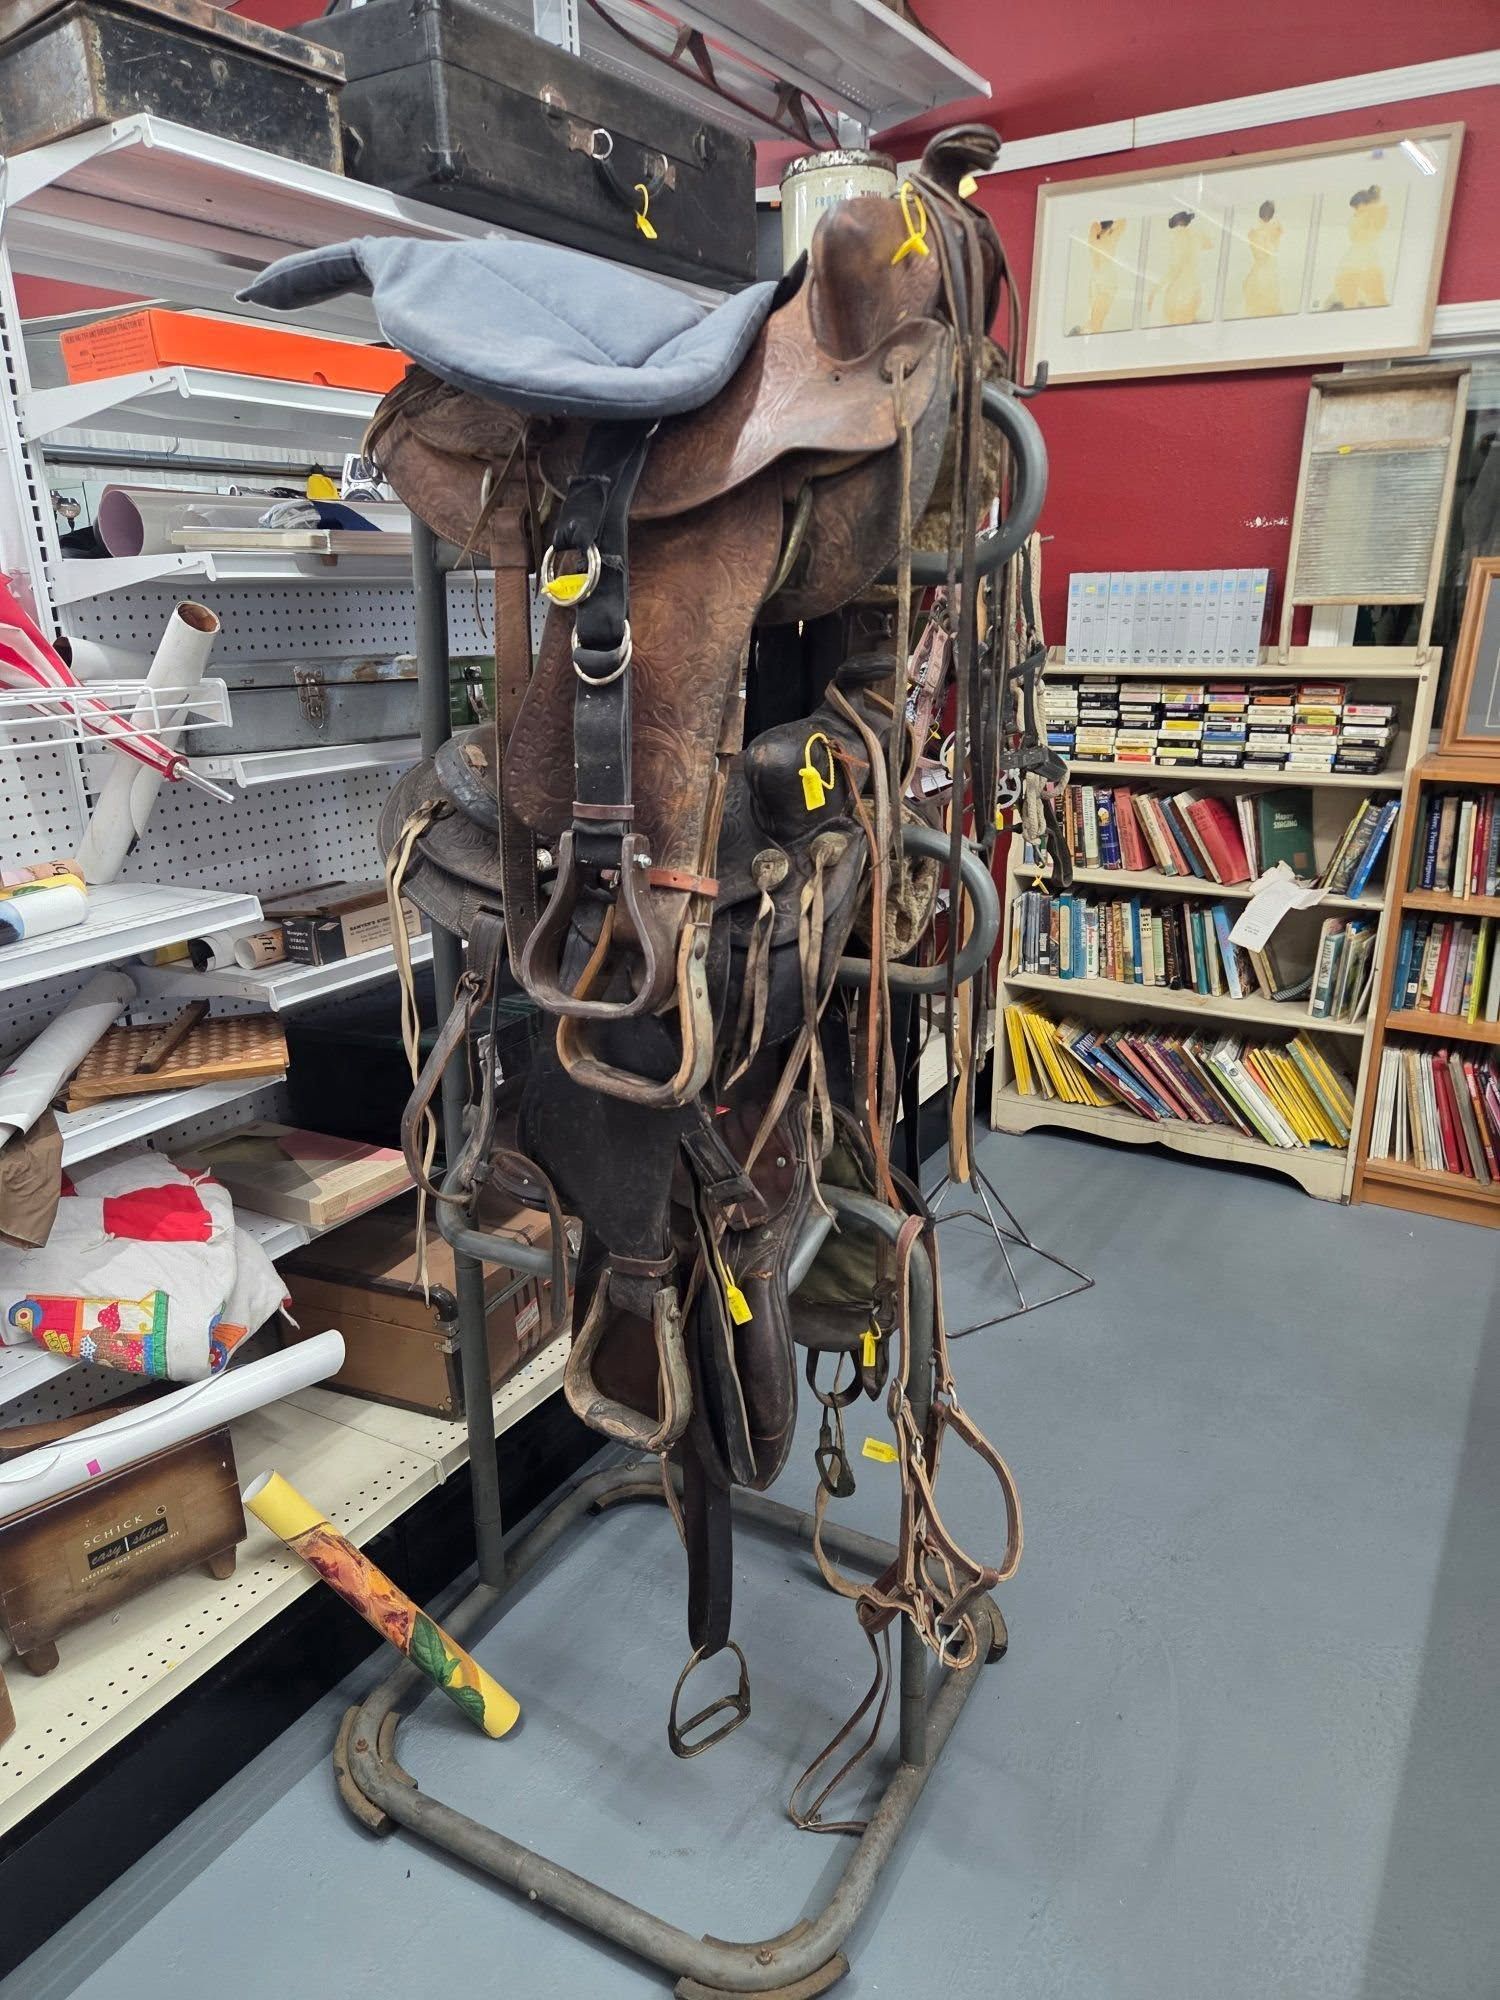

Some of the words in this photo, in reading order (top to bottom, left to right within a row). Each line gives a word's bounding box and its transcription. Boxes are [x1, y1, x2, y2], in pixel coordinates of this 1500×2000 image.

[1428, 831, 1439, 855] Private
[83, 1515, 143, 1549] SCHICK
[92, 1545, 121, 1565] easy
[132, 1524, 165, 1545] shine
[81, 1566, 110, 1582] ELECTRIC
[116, 1556, 131, 1565] SHOE
[136, 1539, 166, 1556] GROOMING
